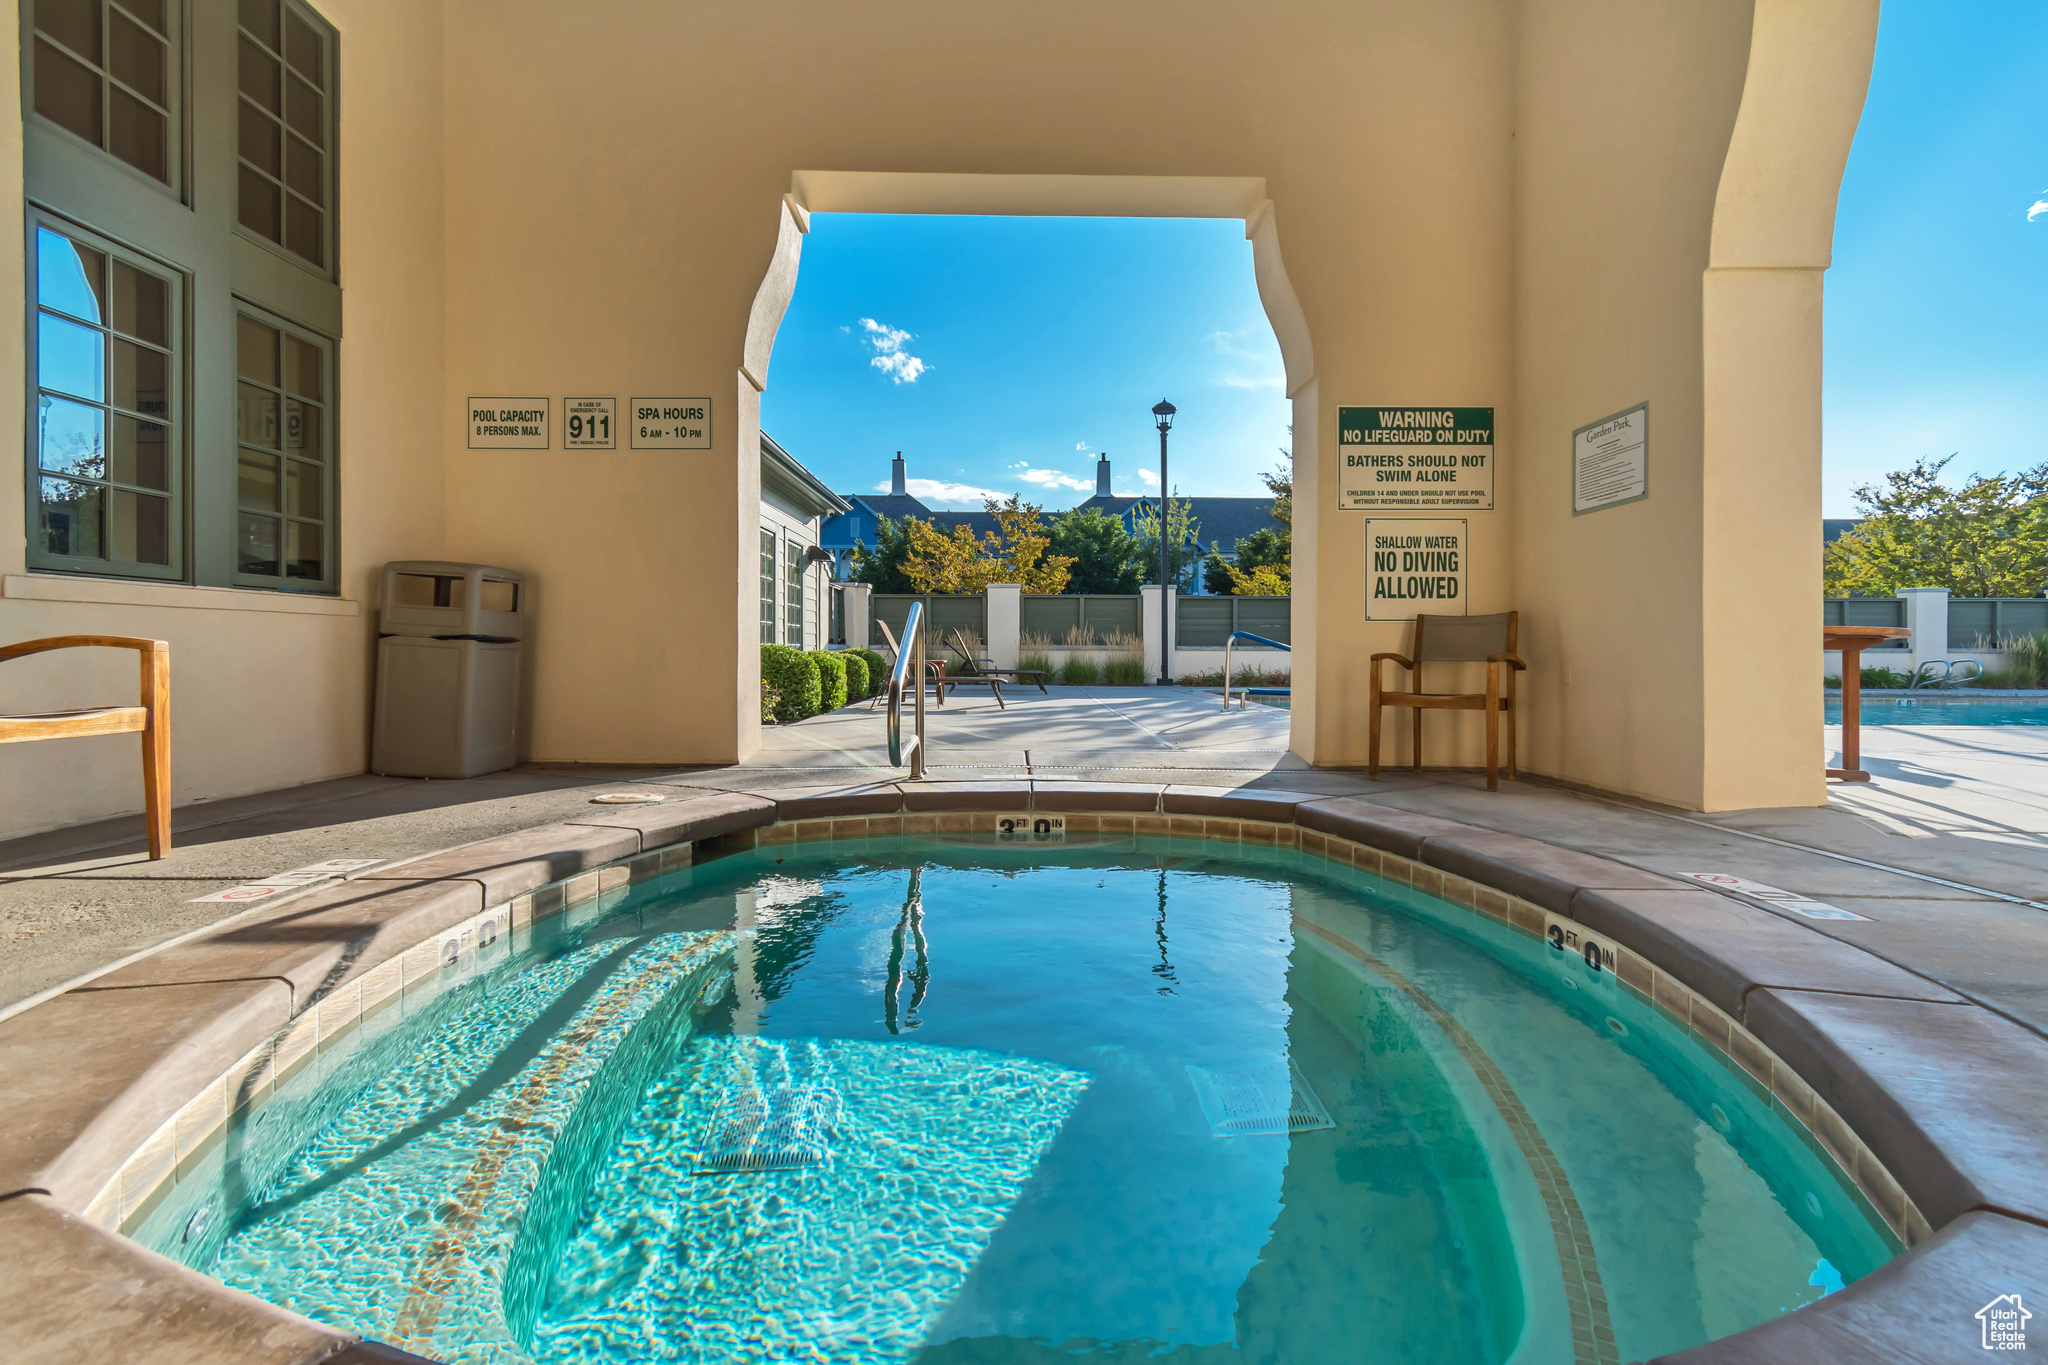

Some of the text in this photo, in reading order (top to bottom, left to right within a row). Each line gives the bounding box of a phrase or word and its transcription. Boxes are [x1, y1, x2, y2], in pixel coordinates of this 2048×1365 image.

[473, 410, 544, 422] POOL CAPACITY
[638, 408, 704, 420] SPA HOURS
[1379, 411, 1454, 428] WARNING
[476, 426, 542, 436] 8 PERSONS MAX.
[569, 415, 609, 438] 911
[640, 426, 648, 438] 6
[650, 430, 662, 438] AM
[674, 426, 687, 438] 10
[690, 430, 702, 438] PM
[1586, 426, 1612, 443] Garden
[1613, 416, 1632, 432] Park
[1344, 430, 1490, 442] NO LIFEGUARD ON DUTY
[1348, 456, 1486, 467] BATHERS SHOULD NOT
[1376, 470, 1456, 482] SWIM ALONE
[1375, 536, 1458, 548] SHALLOW WATER
[1374, 551, 1458, 572] NO DIVING
[1374, 576, 1458, 599] ALLOWED
[1548, 924, 1564, 952] 3
